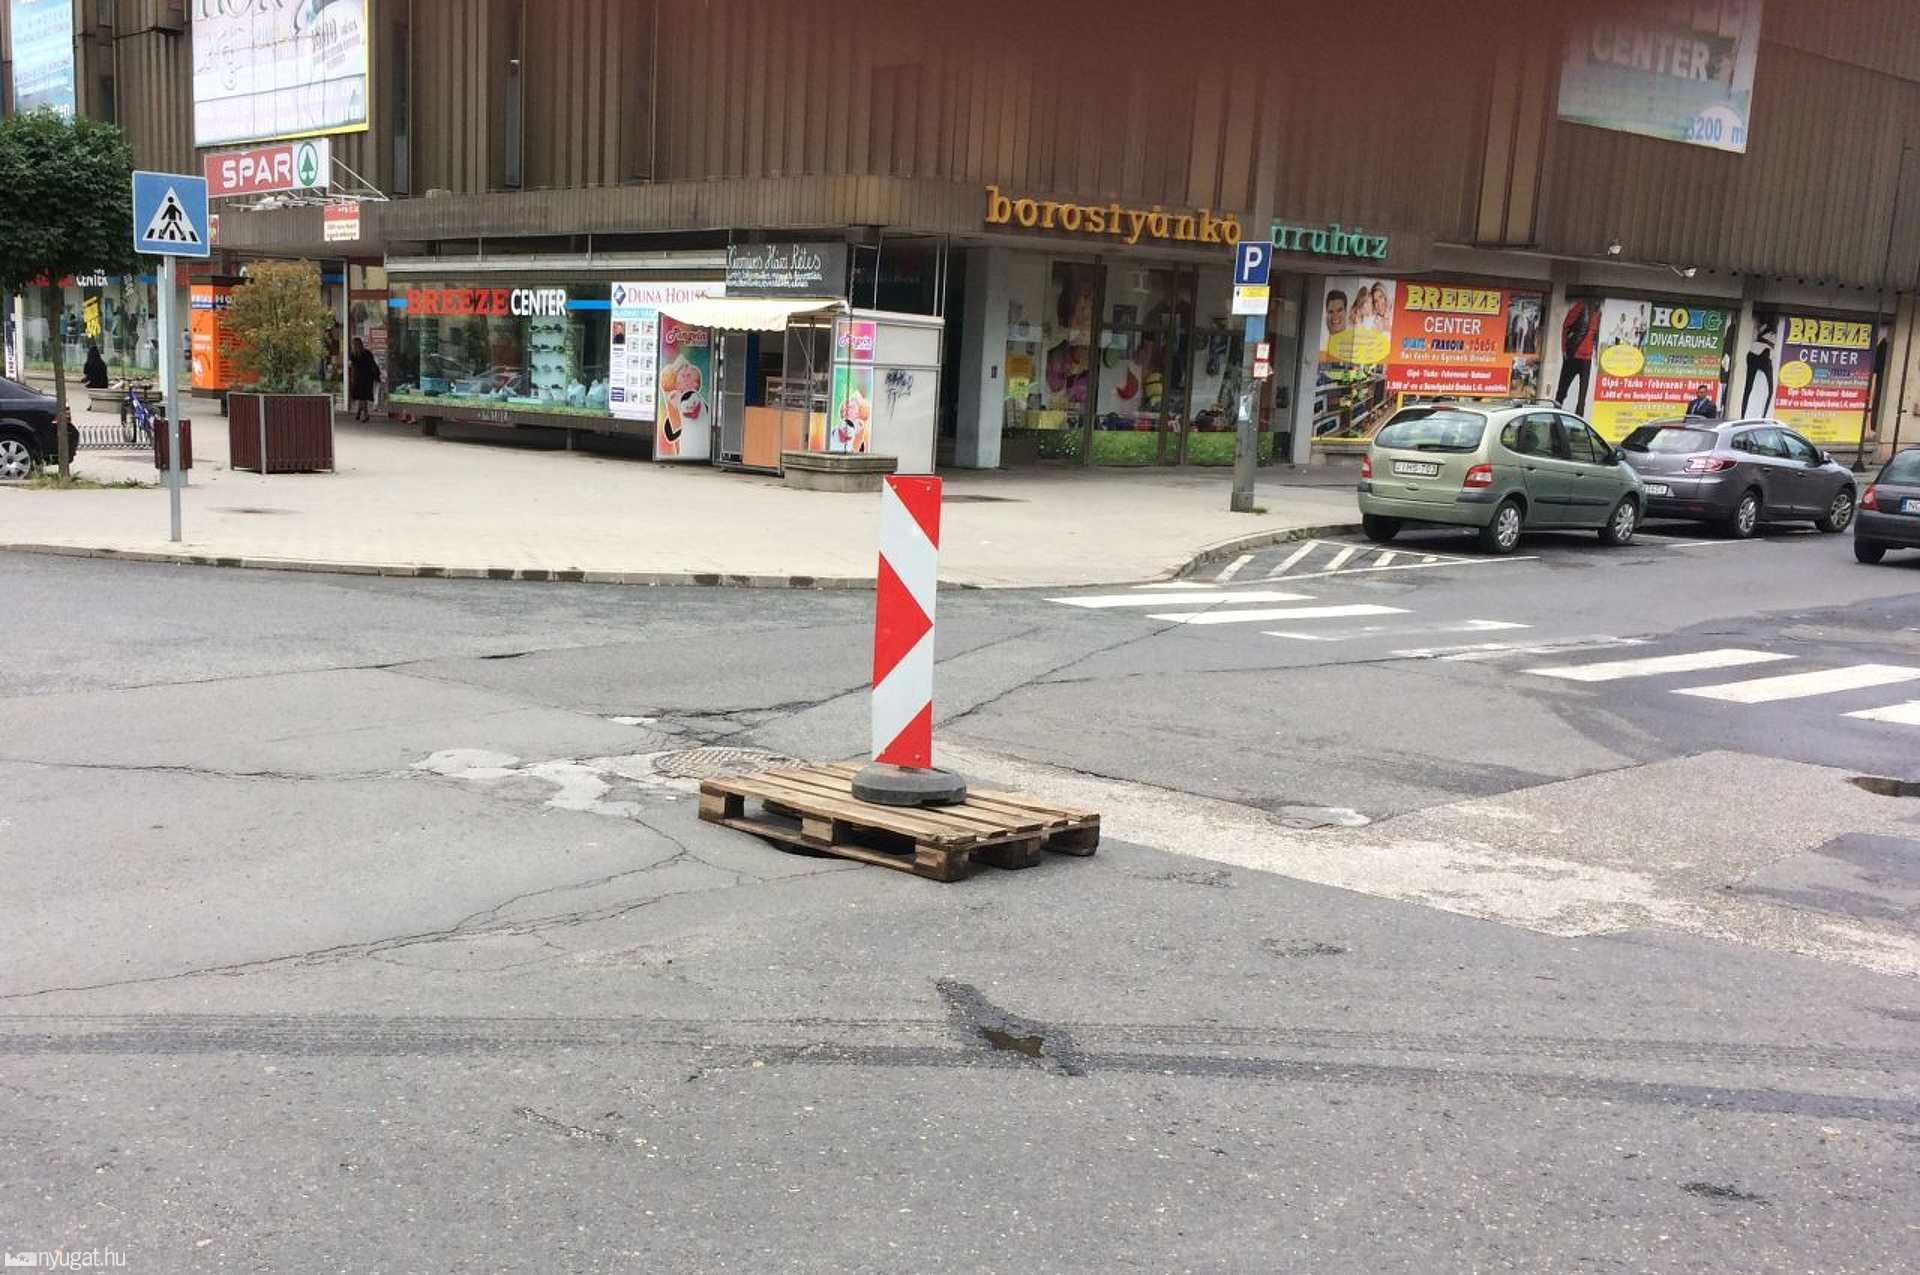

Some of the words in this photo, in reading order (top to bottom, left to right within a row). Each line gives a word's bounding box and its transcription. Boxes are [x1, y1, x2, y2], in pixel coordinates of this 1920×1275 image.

[222, 153, 291, 189] SPAR
[1243, 246, 1263, 281] P
[406, 288, 510, 316] BREEZE
[510, 288, 567, 316] CENTER
[1404, 284, 1501, 315] BREEZE
[1424, 316, 1481, 334] CENTER
[1787, 317, 1873, 348] BREEZE
[1799, 349, 1858, 365] CENTER
